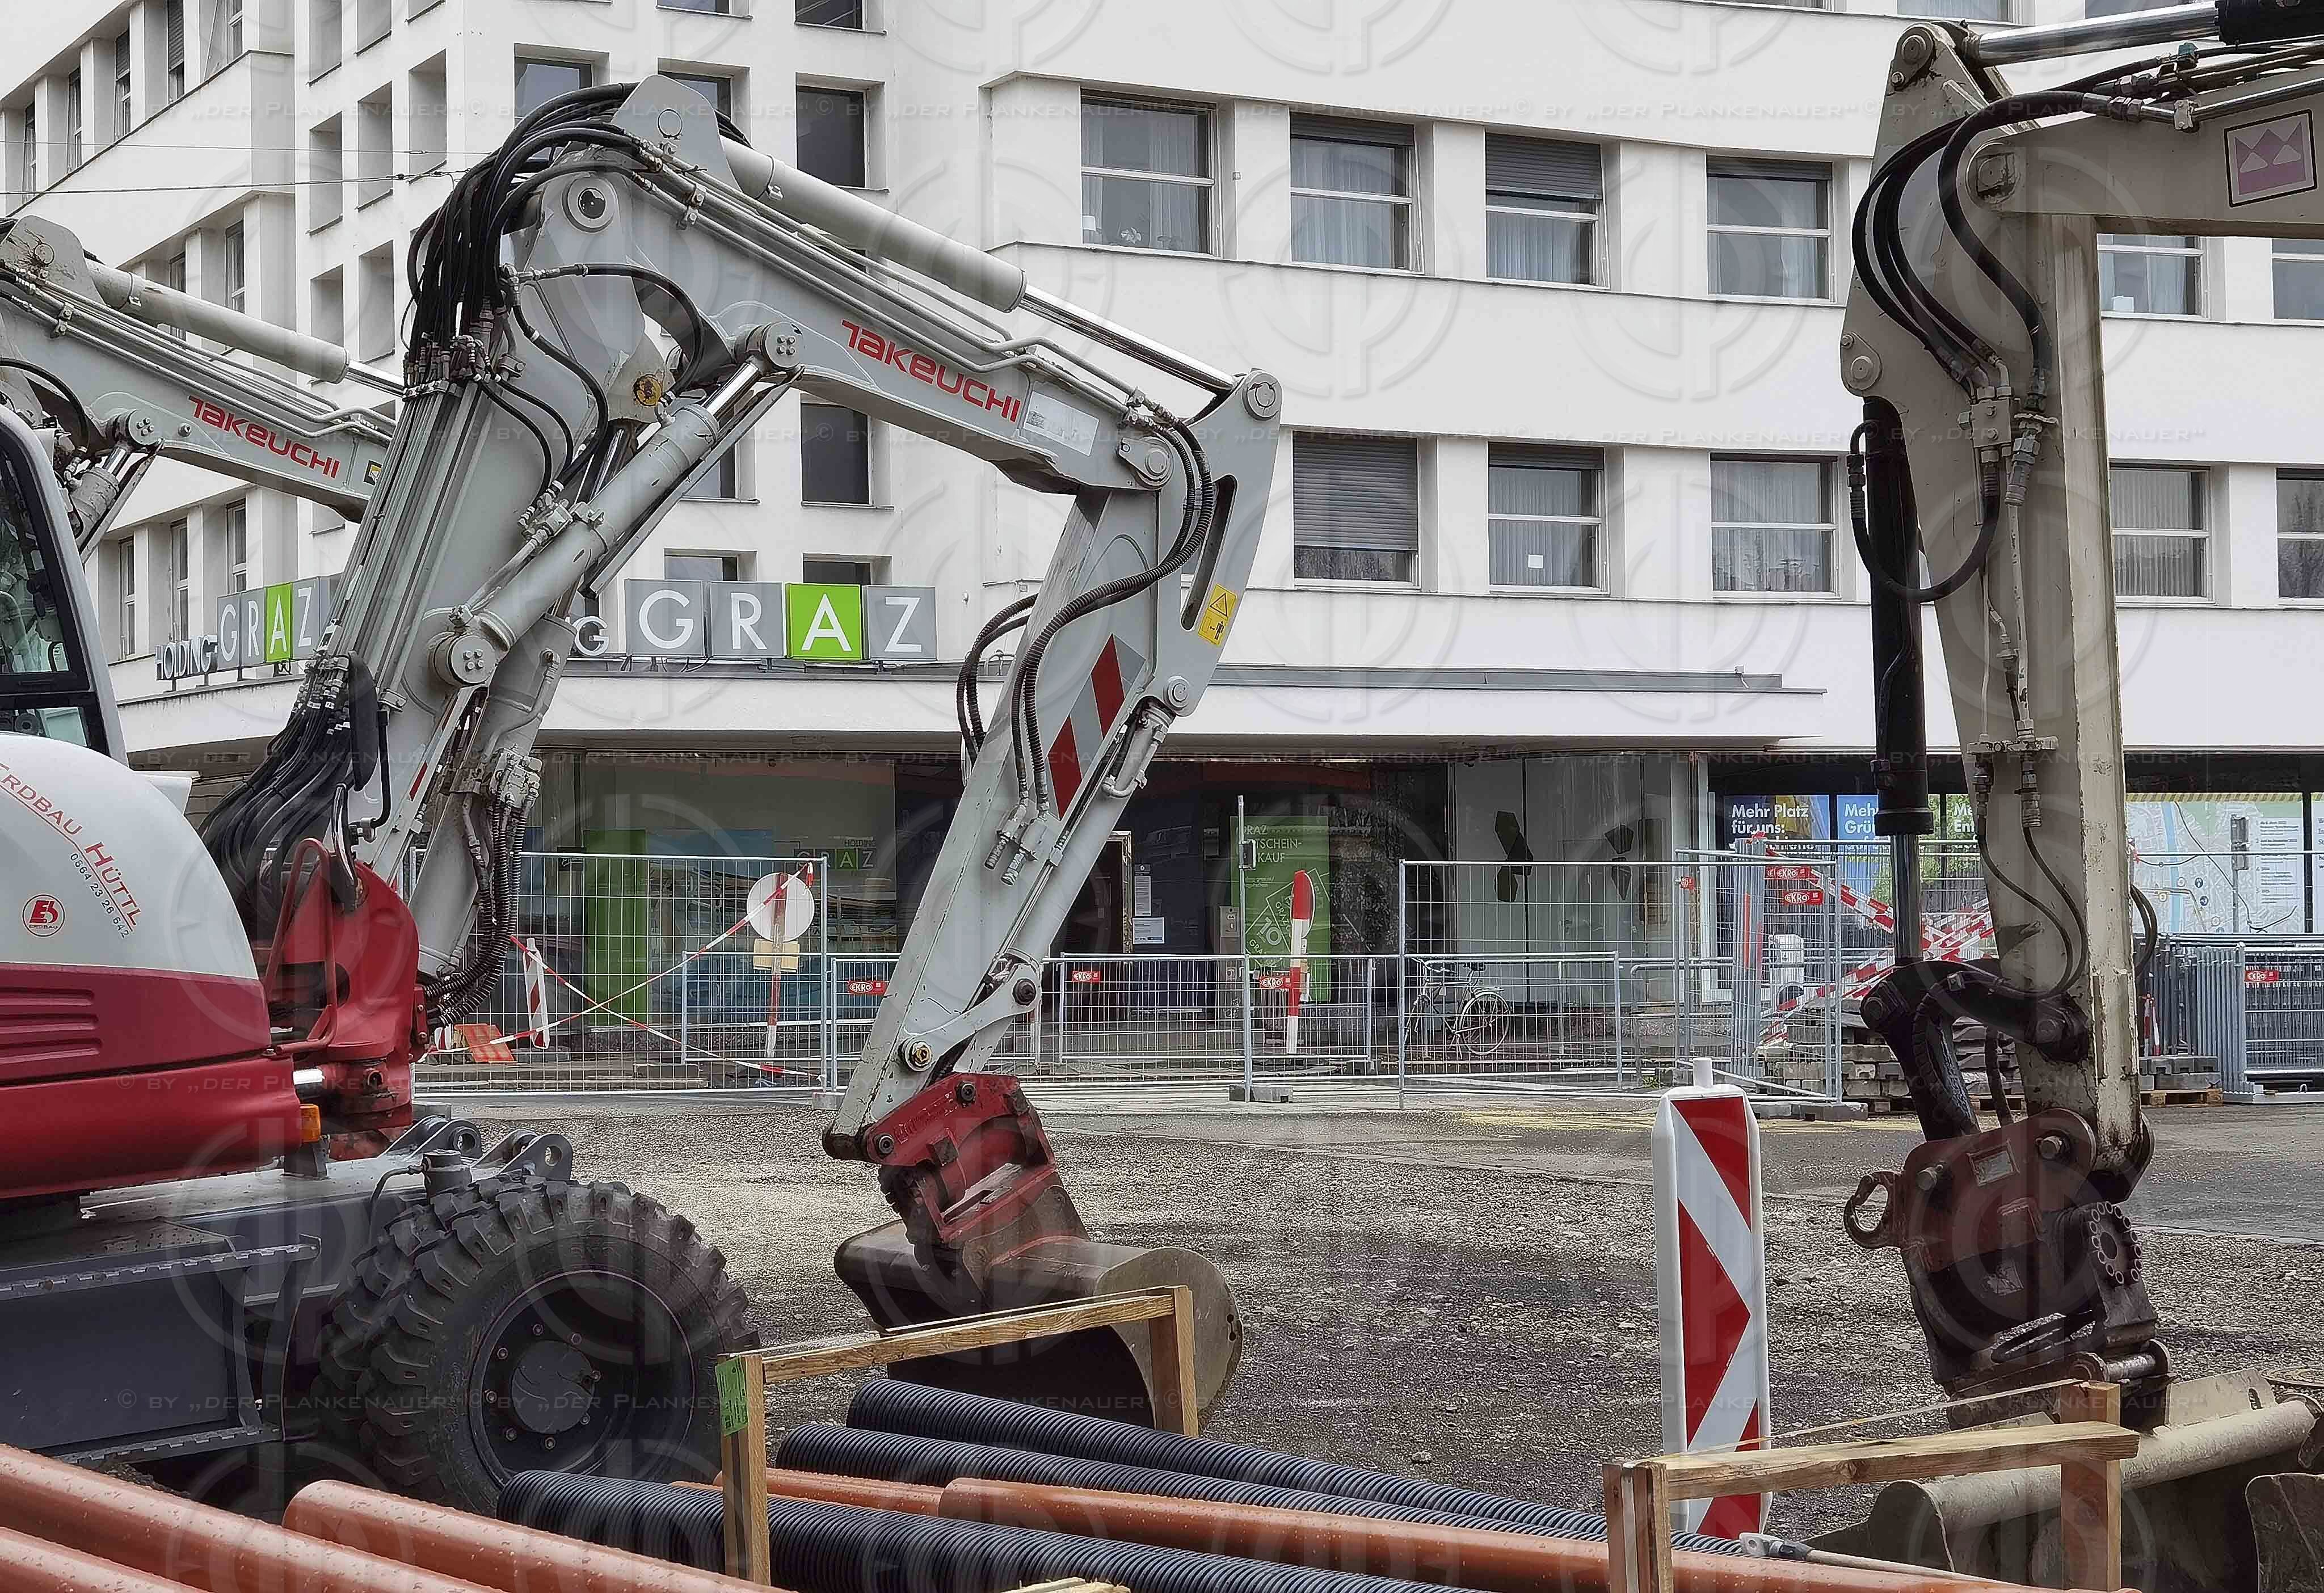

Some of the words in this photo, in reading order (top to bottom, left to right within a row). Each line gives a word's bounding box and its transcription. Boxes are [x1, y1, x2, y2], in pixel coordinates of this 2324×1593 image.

[220, 587, 313, 661] GRAZ
[639, 589, 922, 653] GRAZ
[1732, 803, 1770, 817] Mehr
[1774, 803, 1809, 817] Platz
[1845, 802, 1876, 817] Meh
[1731, 820, 1753, 834] für
[1756, 824, 1785, 834] uns:
[1845, 820, 1875, 834] Grü
[0, 763, 82, 835] RDBAU
[84, 842, 141, 926] HÜTTL
[70, 853, 92, 880] 0664
[90, 883, 103, 897] 23
[101, 900, 115, 914] 26
[112, 917, 130, 939] 642
[1786, 893, 1808, 903] EKRO
[851, 983, 872, 992] EKRO
[1262, 977, 1282, 987] EKRO
